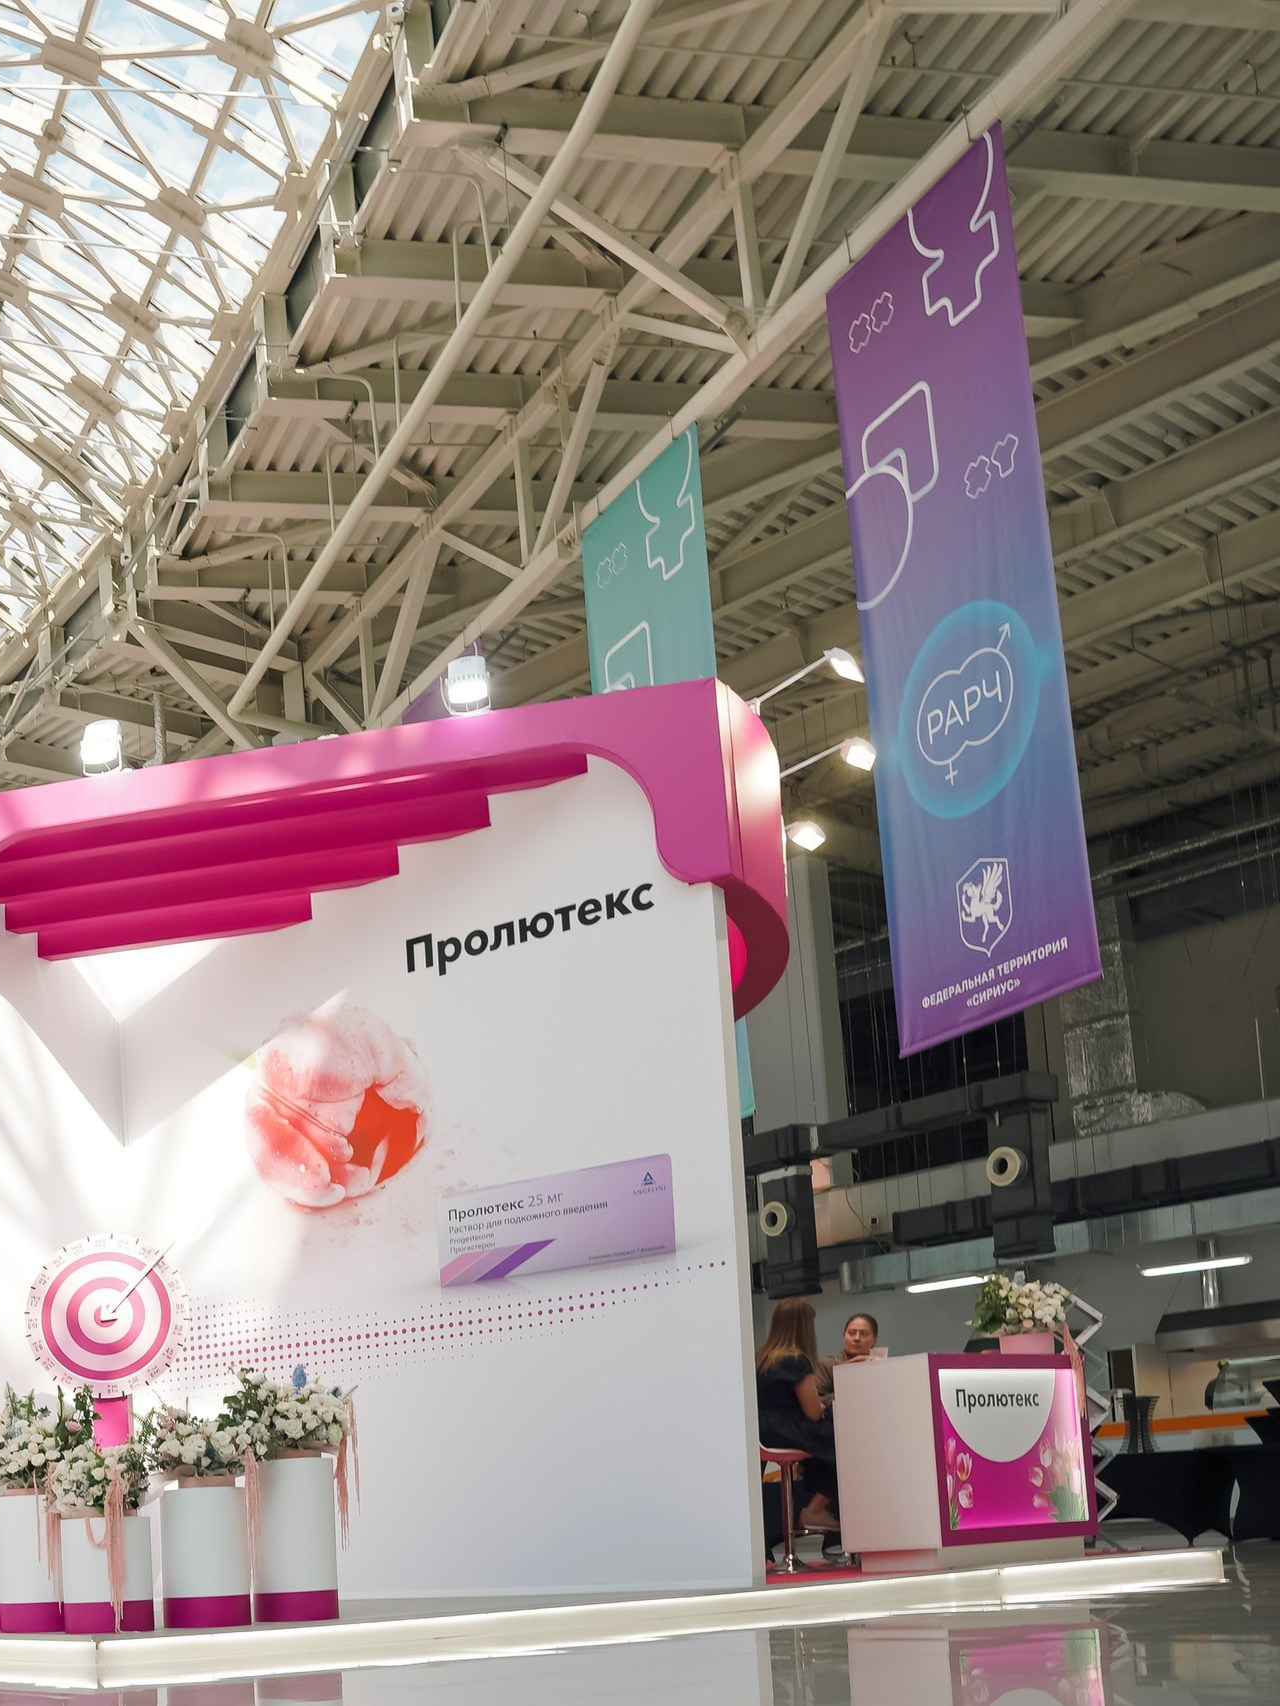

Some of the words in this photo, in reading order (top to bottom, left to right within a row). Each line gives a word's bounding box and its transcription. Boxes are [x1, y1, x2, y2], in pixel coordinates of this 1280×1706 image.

[927, 670, 1003, 745] РАРЧ
[405, 882, 655, 977] Пролютекс
[922, 967, 995, 1009] ФЕДЕРАЛЬНАЯ
[997, 936, 1068, 977] ТЕРРИТОРИЯ
[966, 977, 1021, 1008] «СИРИУС»
[632, 1185, 666, 1196] ANGELINI
[448, 1198, 525, 1222] Пролютекс
[527, 1194, 543, 1208] 25
[547, 1193, 563, 1205] мг
[448, 1221, 485, 1236] Раствор
[486, 1219, 503, 1230] для
[504, 1208, 561, 1227] подкожного
[563, 1200, 609, 1216] введения
[449, 1231, 495, 1246] Progesterone
[449, 1241, 496, 1255] Прогестерон
[955, 1389, 1040, 1414] Пролютекс
